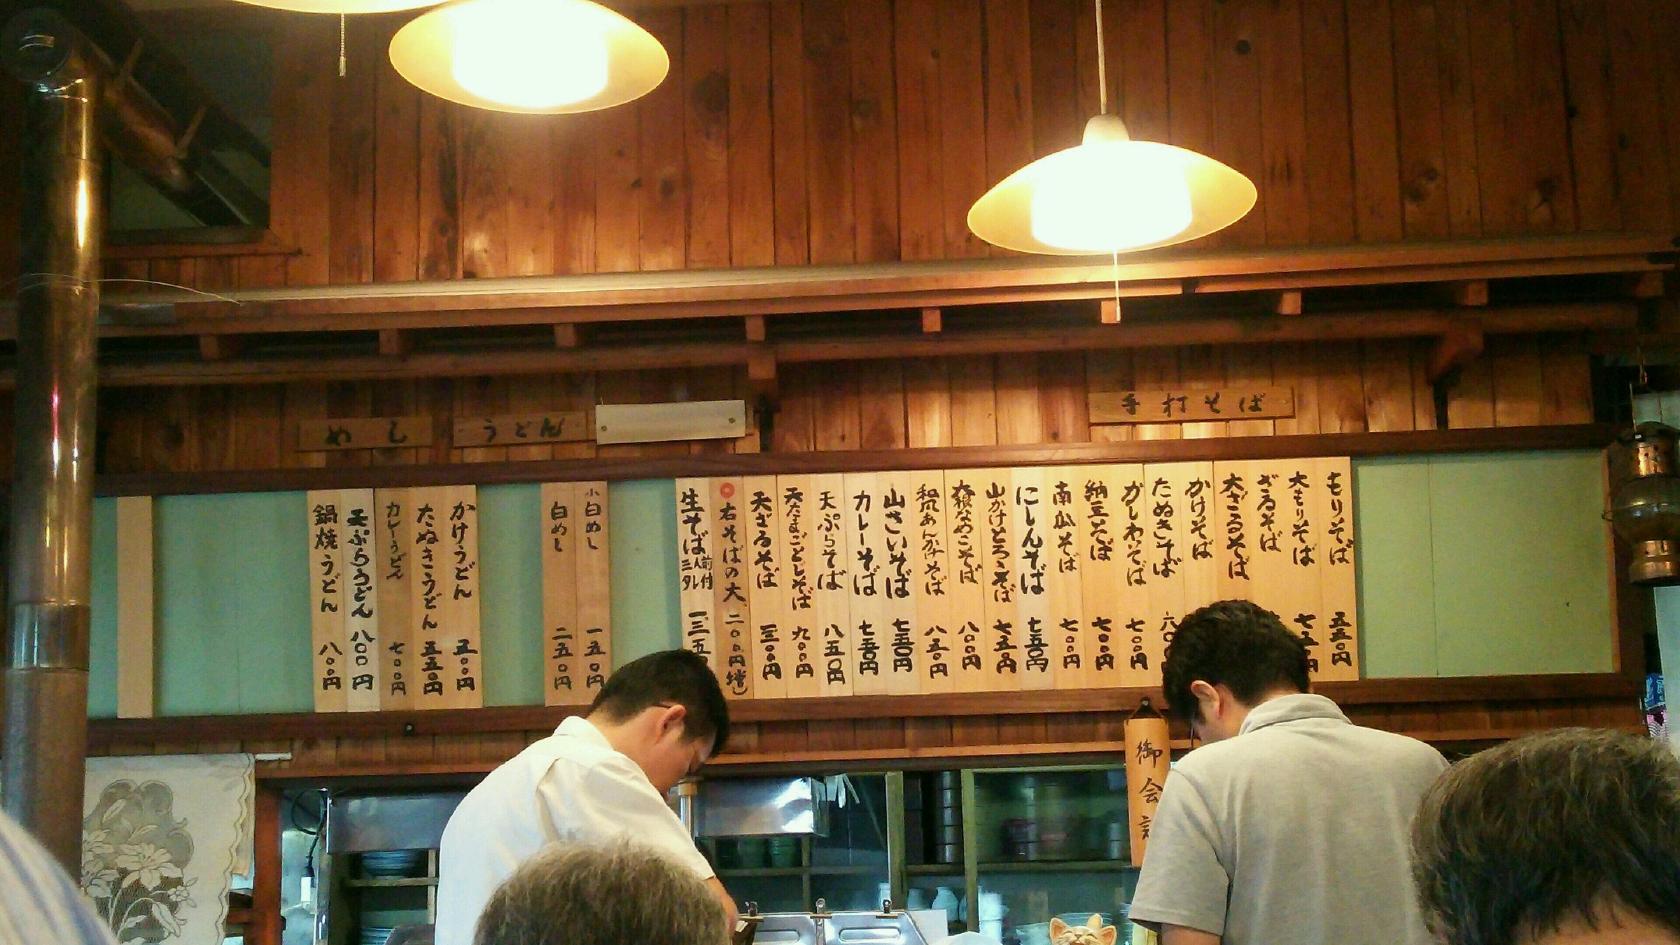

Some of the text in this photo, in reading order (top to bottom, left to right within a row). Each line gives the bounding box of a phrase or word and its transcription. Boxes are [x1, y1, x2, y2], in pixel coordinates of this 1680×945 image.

[325, 421, 407, 446] めし
[484, 417, 565, 443] うどん
[313, 504, 340, 612] 鍋焼うどん
[386, 501, 407, 579] カレーうどん
[450, 501, 476, 600] かけうどん
[551, 501, 567, 552] 白めし
[680, 488, 709, 554] 生そば
[750, 491, 779, 589] 天ざるそば
[817, 491, 846, 590] 天ぷらそば
[853, 490, 880, 596] カレーそば
[883, 487, 912, 599] 山さいそば
[1016, 486, 1047, 595] にしんそば
[1053, 481, 1080, 573] 南瓜そば
[1084, 479, 1113, 561] 納豆そば
[1151, 477, 1182, 578] たぬきそば
[1184, 477, 1214, 561] かけそば
[1257, 474, 1283, 553] ざるそば
[1288, 471, 1317, 566] 大もりそば
[1326, 471, 1354, 565] もりそば
[415, 504, 442, 630] たぬきうどん
